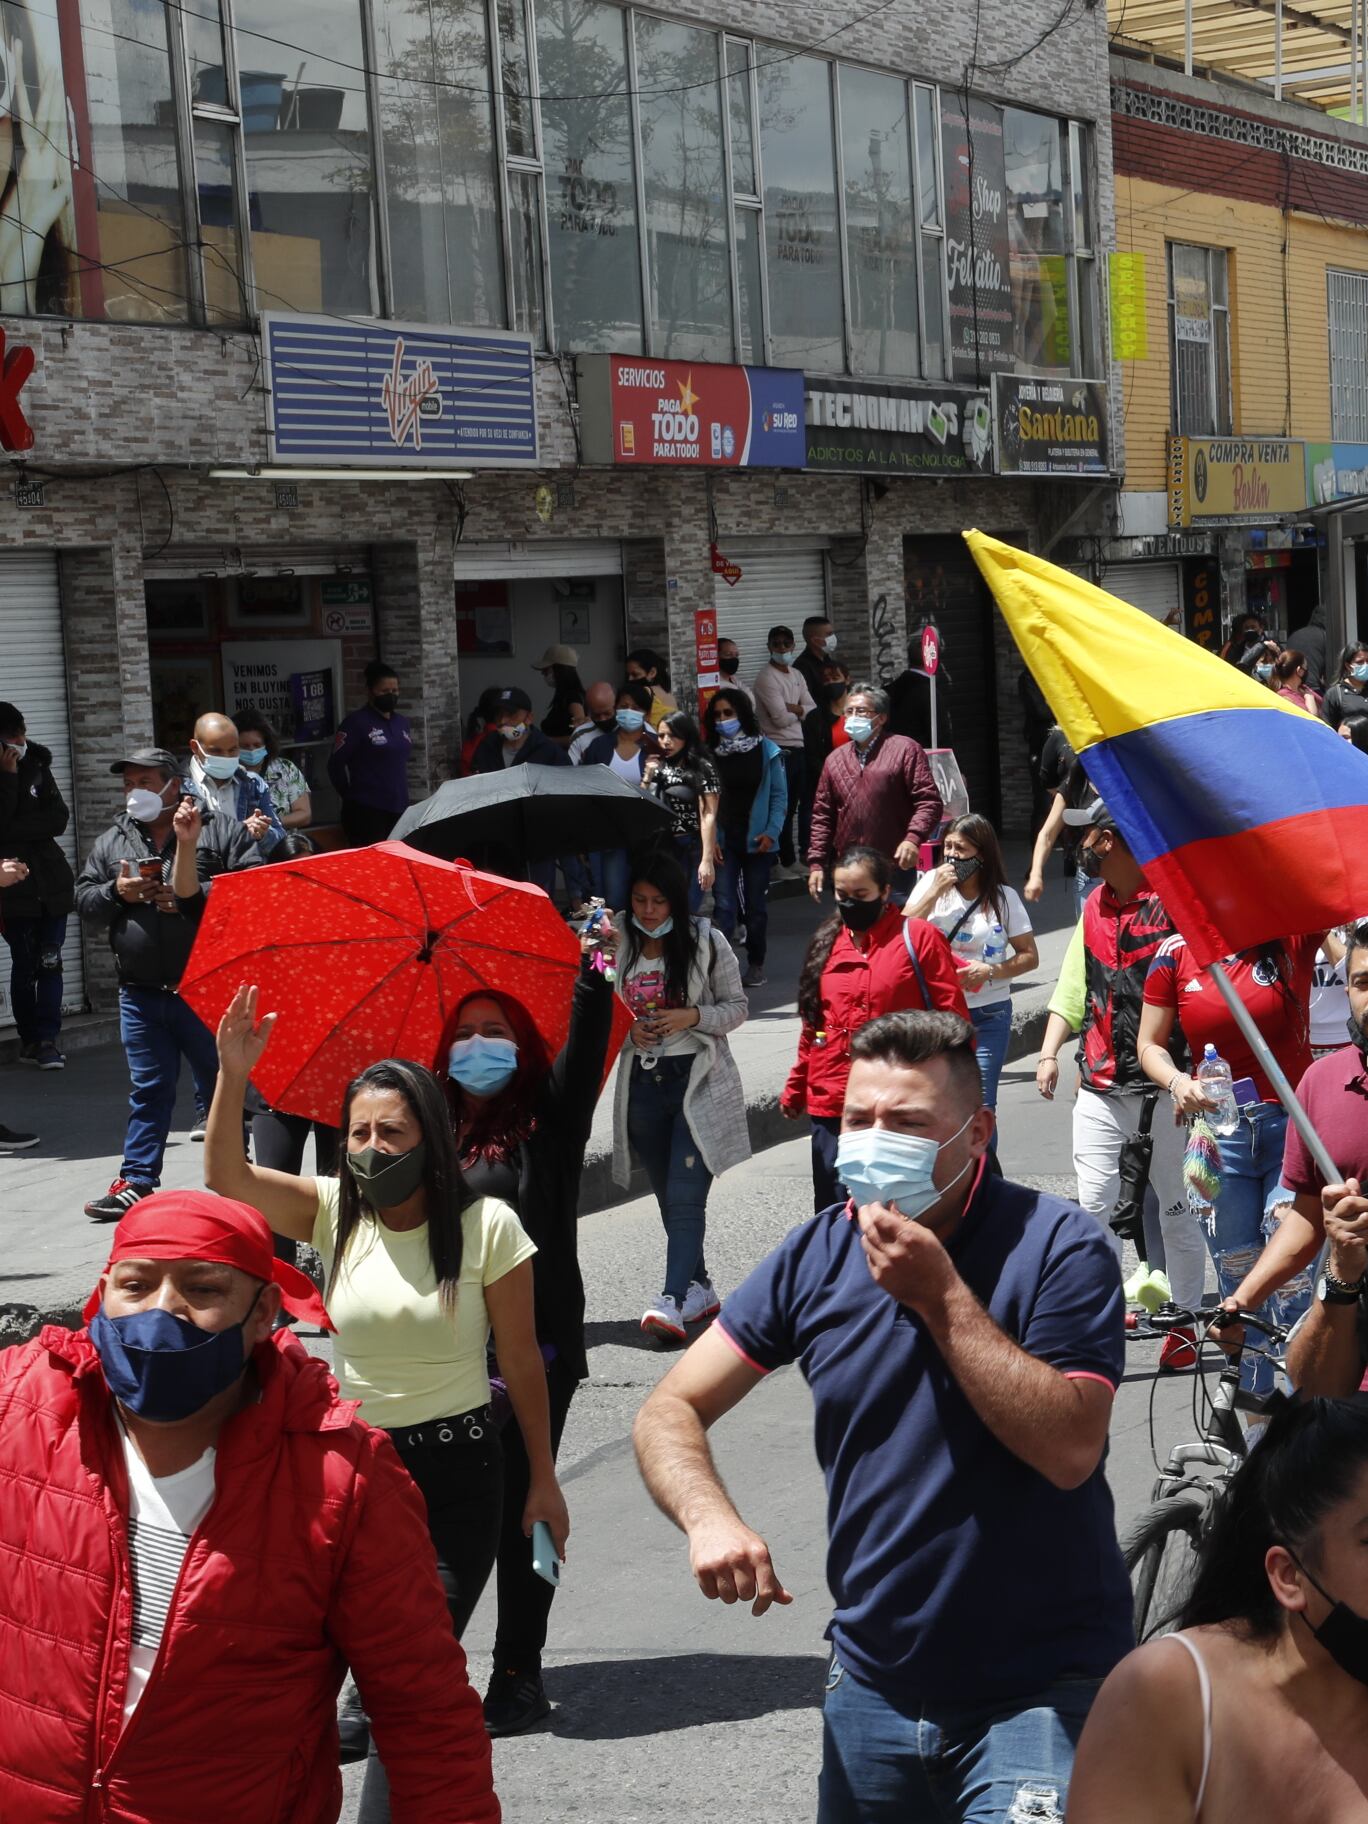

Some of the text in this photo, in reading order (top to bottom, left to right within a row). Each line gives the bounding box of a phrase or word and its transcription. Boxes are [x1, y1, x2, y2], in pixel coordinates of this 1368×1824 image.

[973, 176, 1000, 223] Shop
[1119, 256, 1137, 297] SEX
[1119, 303, 1138, 357] SHOP
[618, 367, 665, 388] SERVICIOS
[658, 398, 681, 413] PAGA
[652, 413, 699, 441] TODO
[1019, 405, 1099, 442] Santana
[808, 447, 863, 462] ADICTOS
[867, 450, 877, 463] A
[880, 454, 897, 465] LA
[1209, 444, 1290, 464] COMPRA VENTA
[232, 664, 278, 678] VENIMOS
[234, 680, 247, 694] EN
[303, 682, 324, 698] 1 GB
[236, 696, 291, 710] NOS GUSTA
